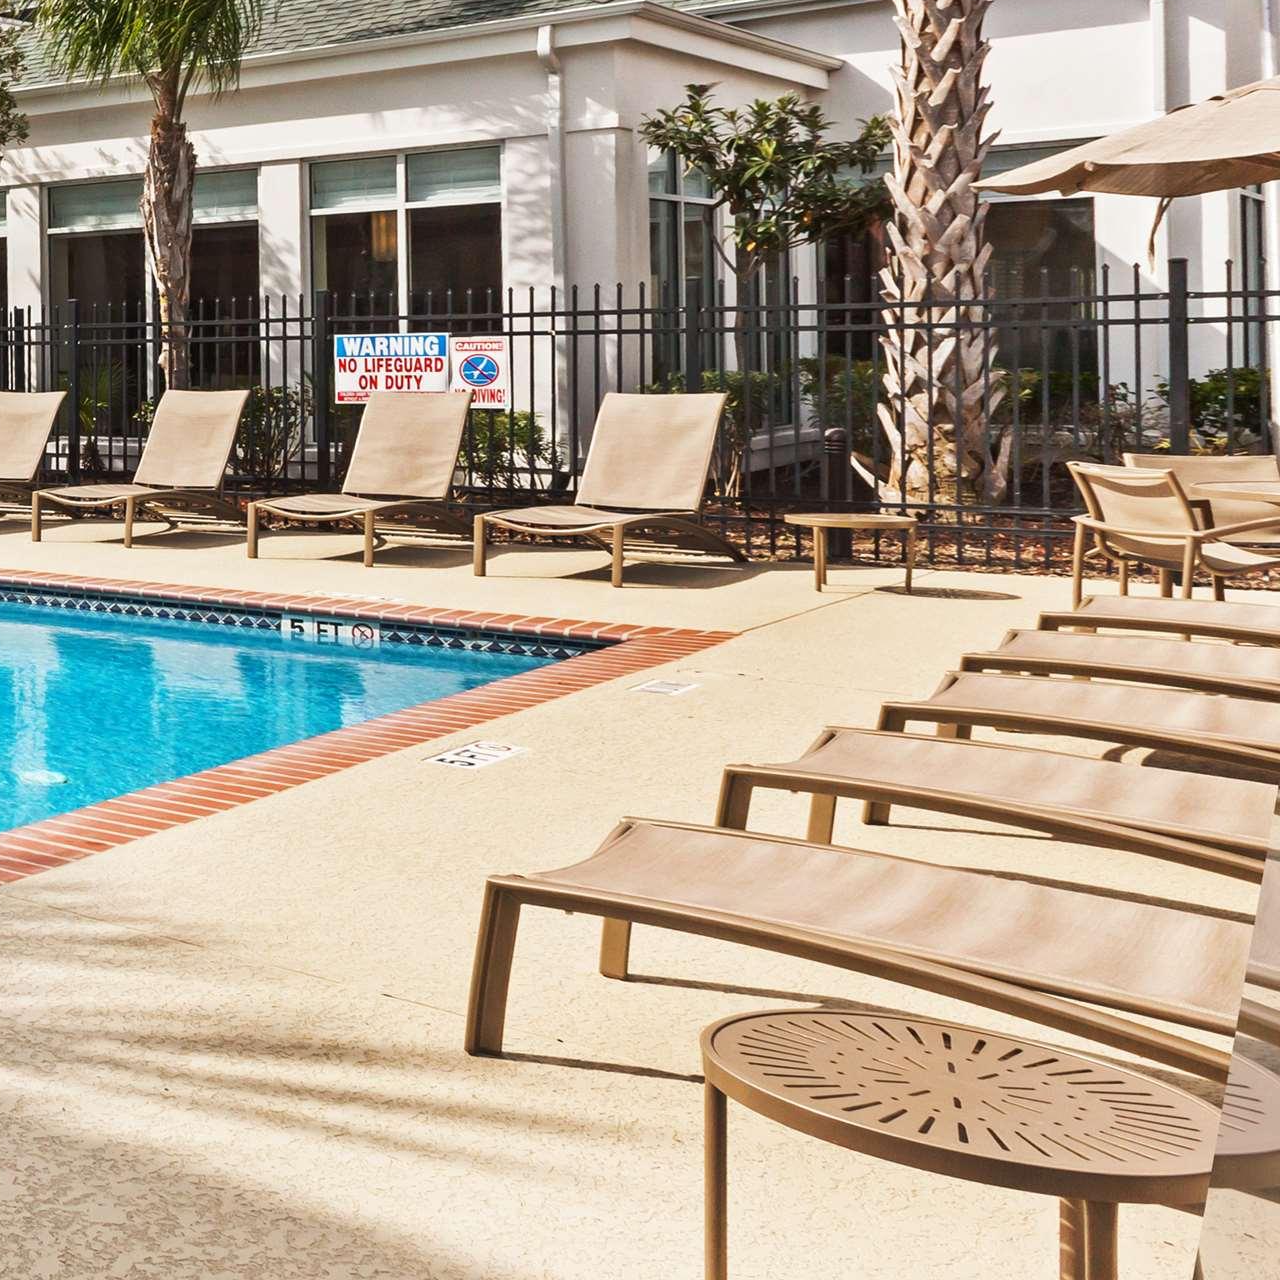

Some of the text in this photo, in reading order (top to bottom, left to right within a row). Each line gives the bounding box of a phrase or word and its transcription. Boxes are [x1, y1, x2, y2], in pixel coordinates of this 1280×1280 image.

[343, 336, 439, 356] WARNING
[338, 357, 444, 373] NO LIFEGUARD
[359, 375, 423, 390] ON DUTY
[290, 618, 344, 637] 5 FT
